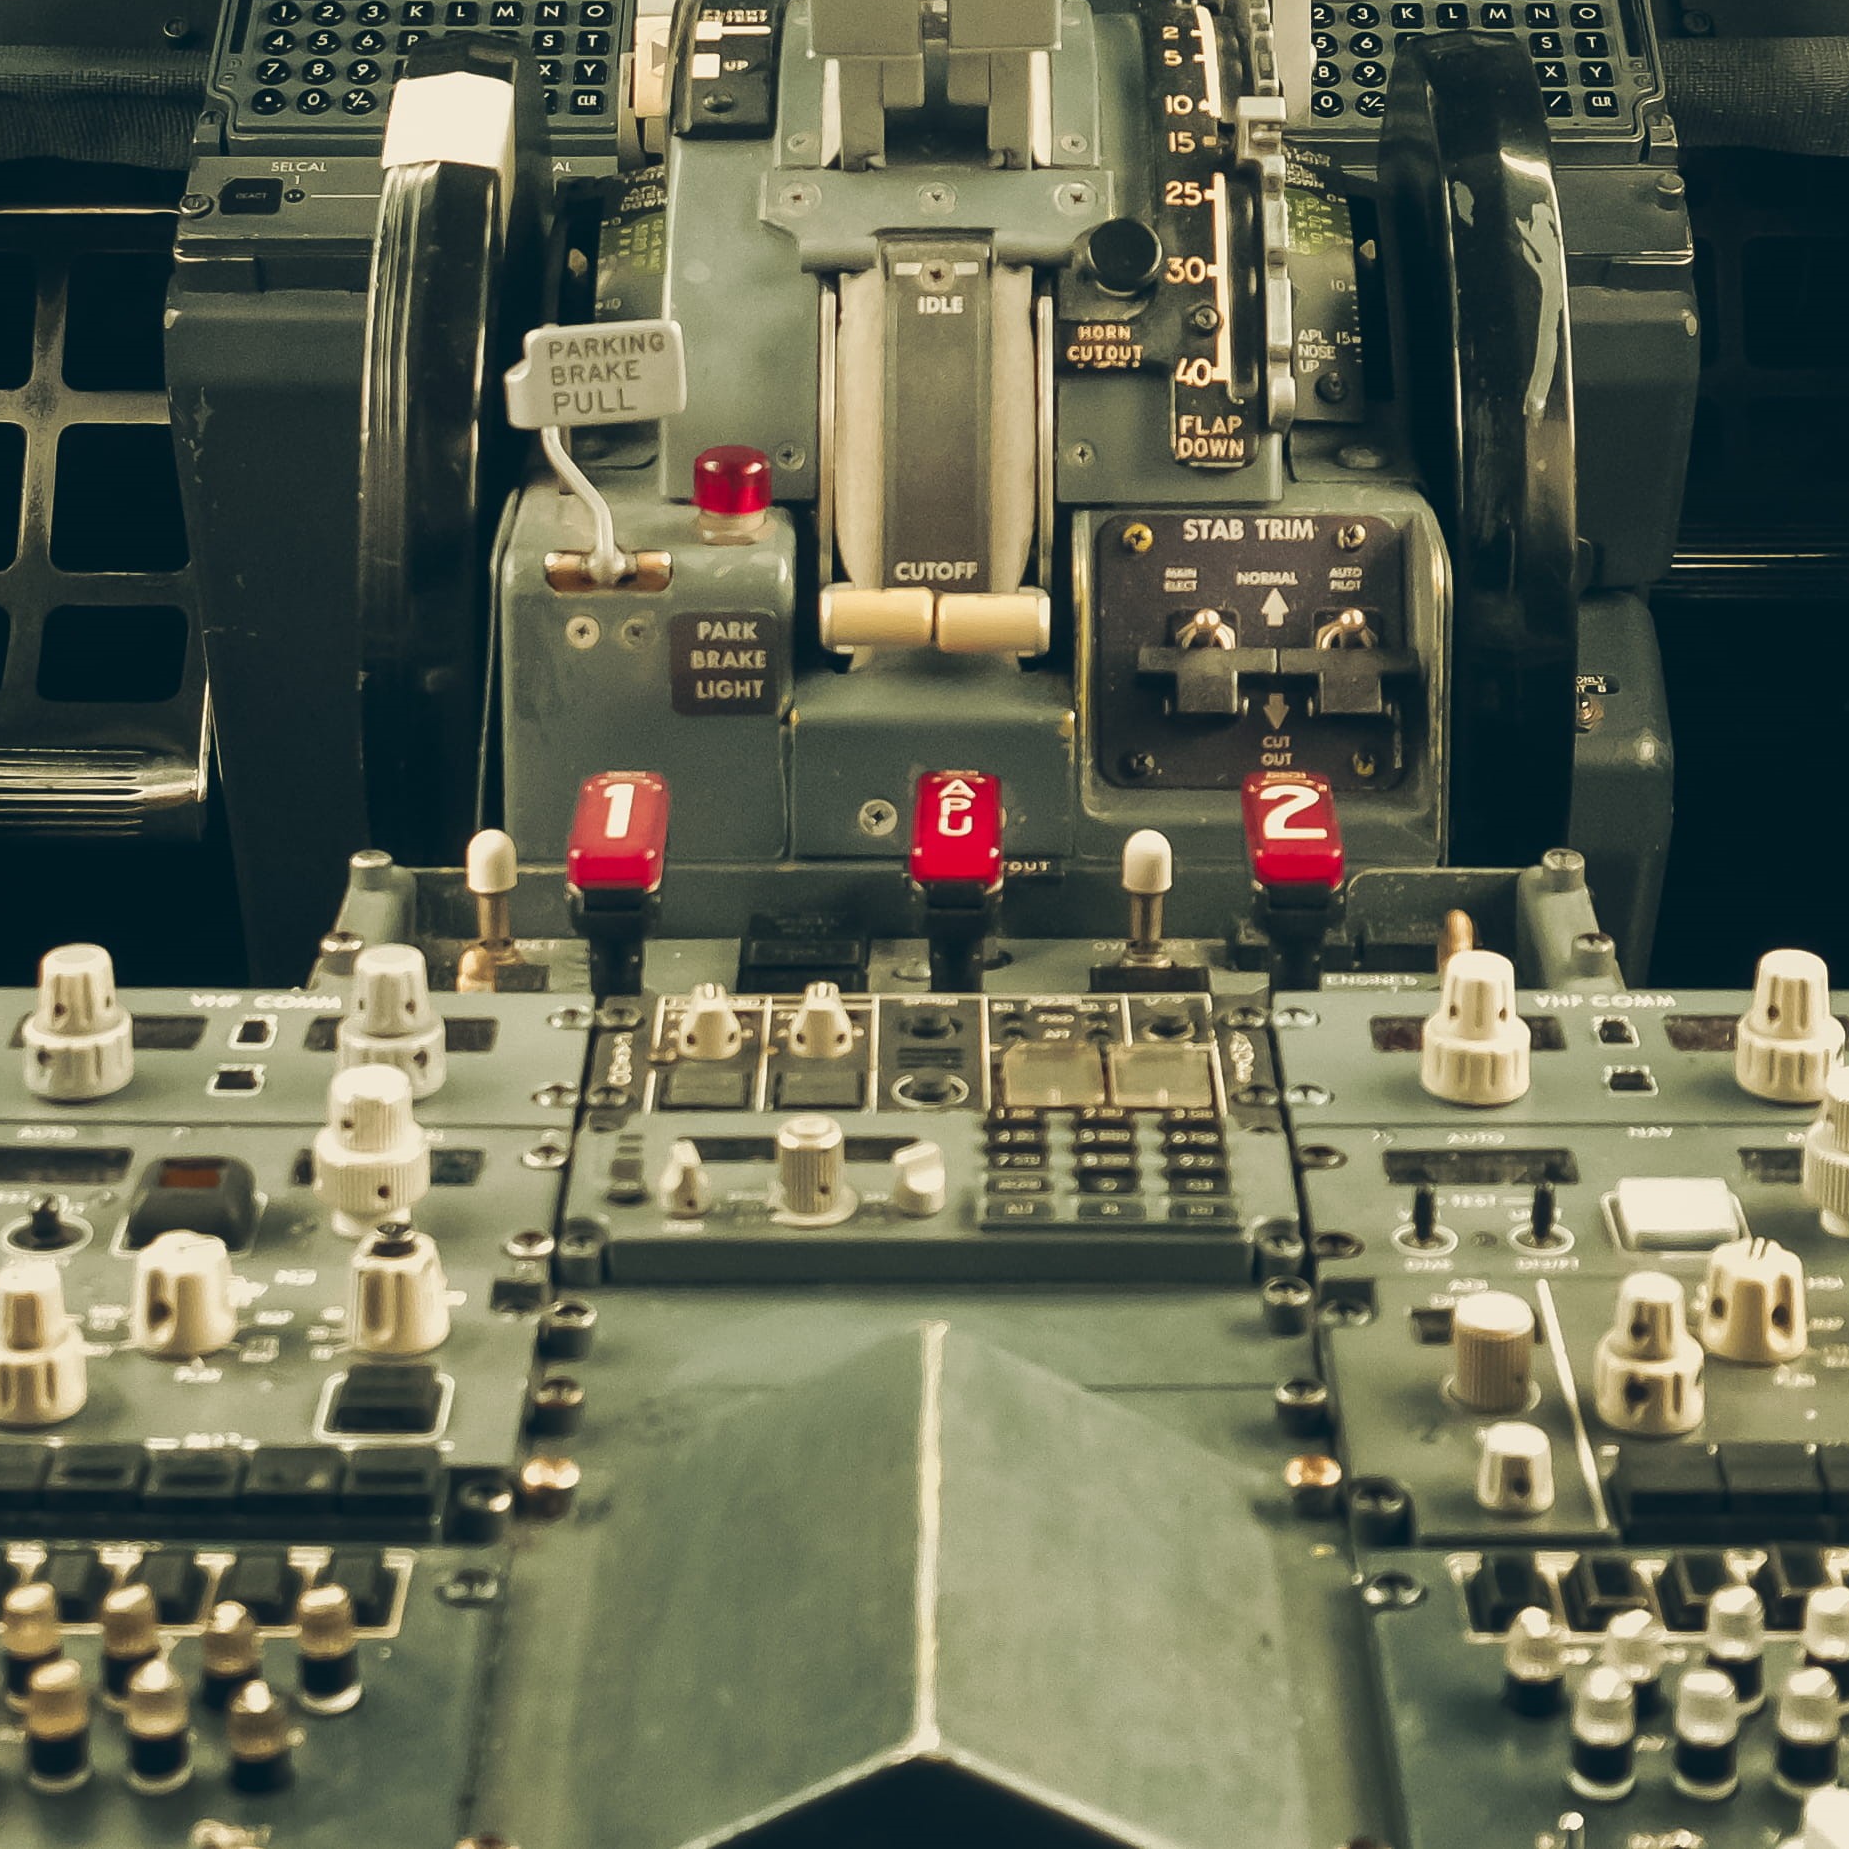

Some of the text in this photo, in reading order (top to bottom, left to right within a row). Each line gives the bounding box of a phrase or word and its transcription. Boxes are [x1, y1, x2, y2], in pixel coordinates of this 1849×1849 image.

[1165, 96, 1193, 113] 10
[1168, 133, 1196, 150] 15
[1165, 184, 1203, 205] 25
[1165, 258, 1206, 283] 30
[918, 297, 964, 314] IDLE
[1077, 326, 1131, 342] HORN
[548, 332, 665, 360] PARKING
[1067, 345, 1143, 362] CUTOUT
[551, 360, 642, 386] BRAKE
[1175, 358, 1211, 385] 40
[553, 388, 638, 416] PULL
[1180, 416, 1242, 436] FLAP
[1178, 438, 1244, 458] DOWN
[1183, 518, 1314, 542] STAB TRIM
[895, 562, 978, 581] CUTOFF
[1236, 572, 1298, 586] NORMAL
[697, 622, 758, 640] PARK
[691, 650, 767, 669] BRAKE
[696, 679, 764, 699] LIGHT
[603, 783, 635, 838] 1
[939, 779, 976, 837] APU
[1263, 785, 1328, 840] 2
